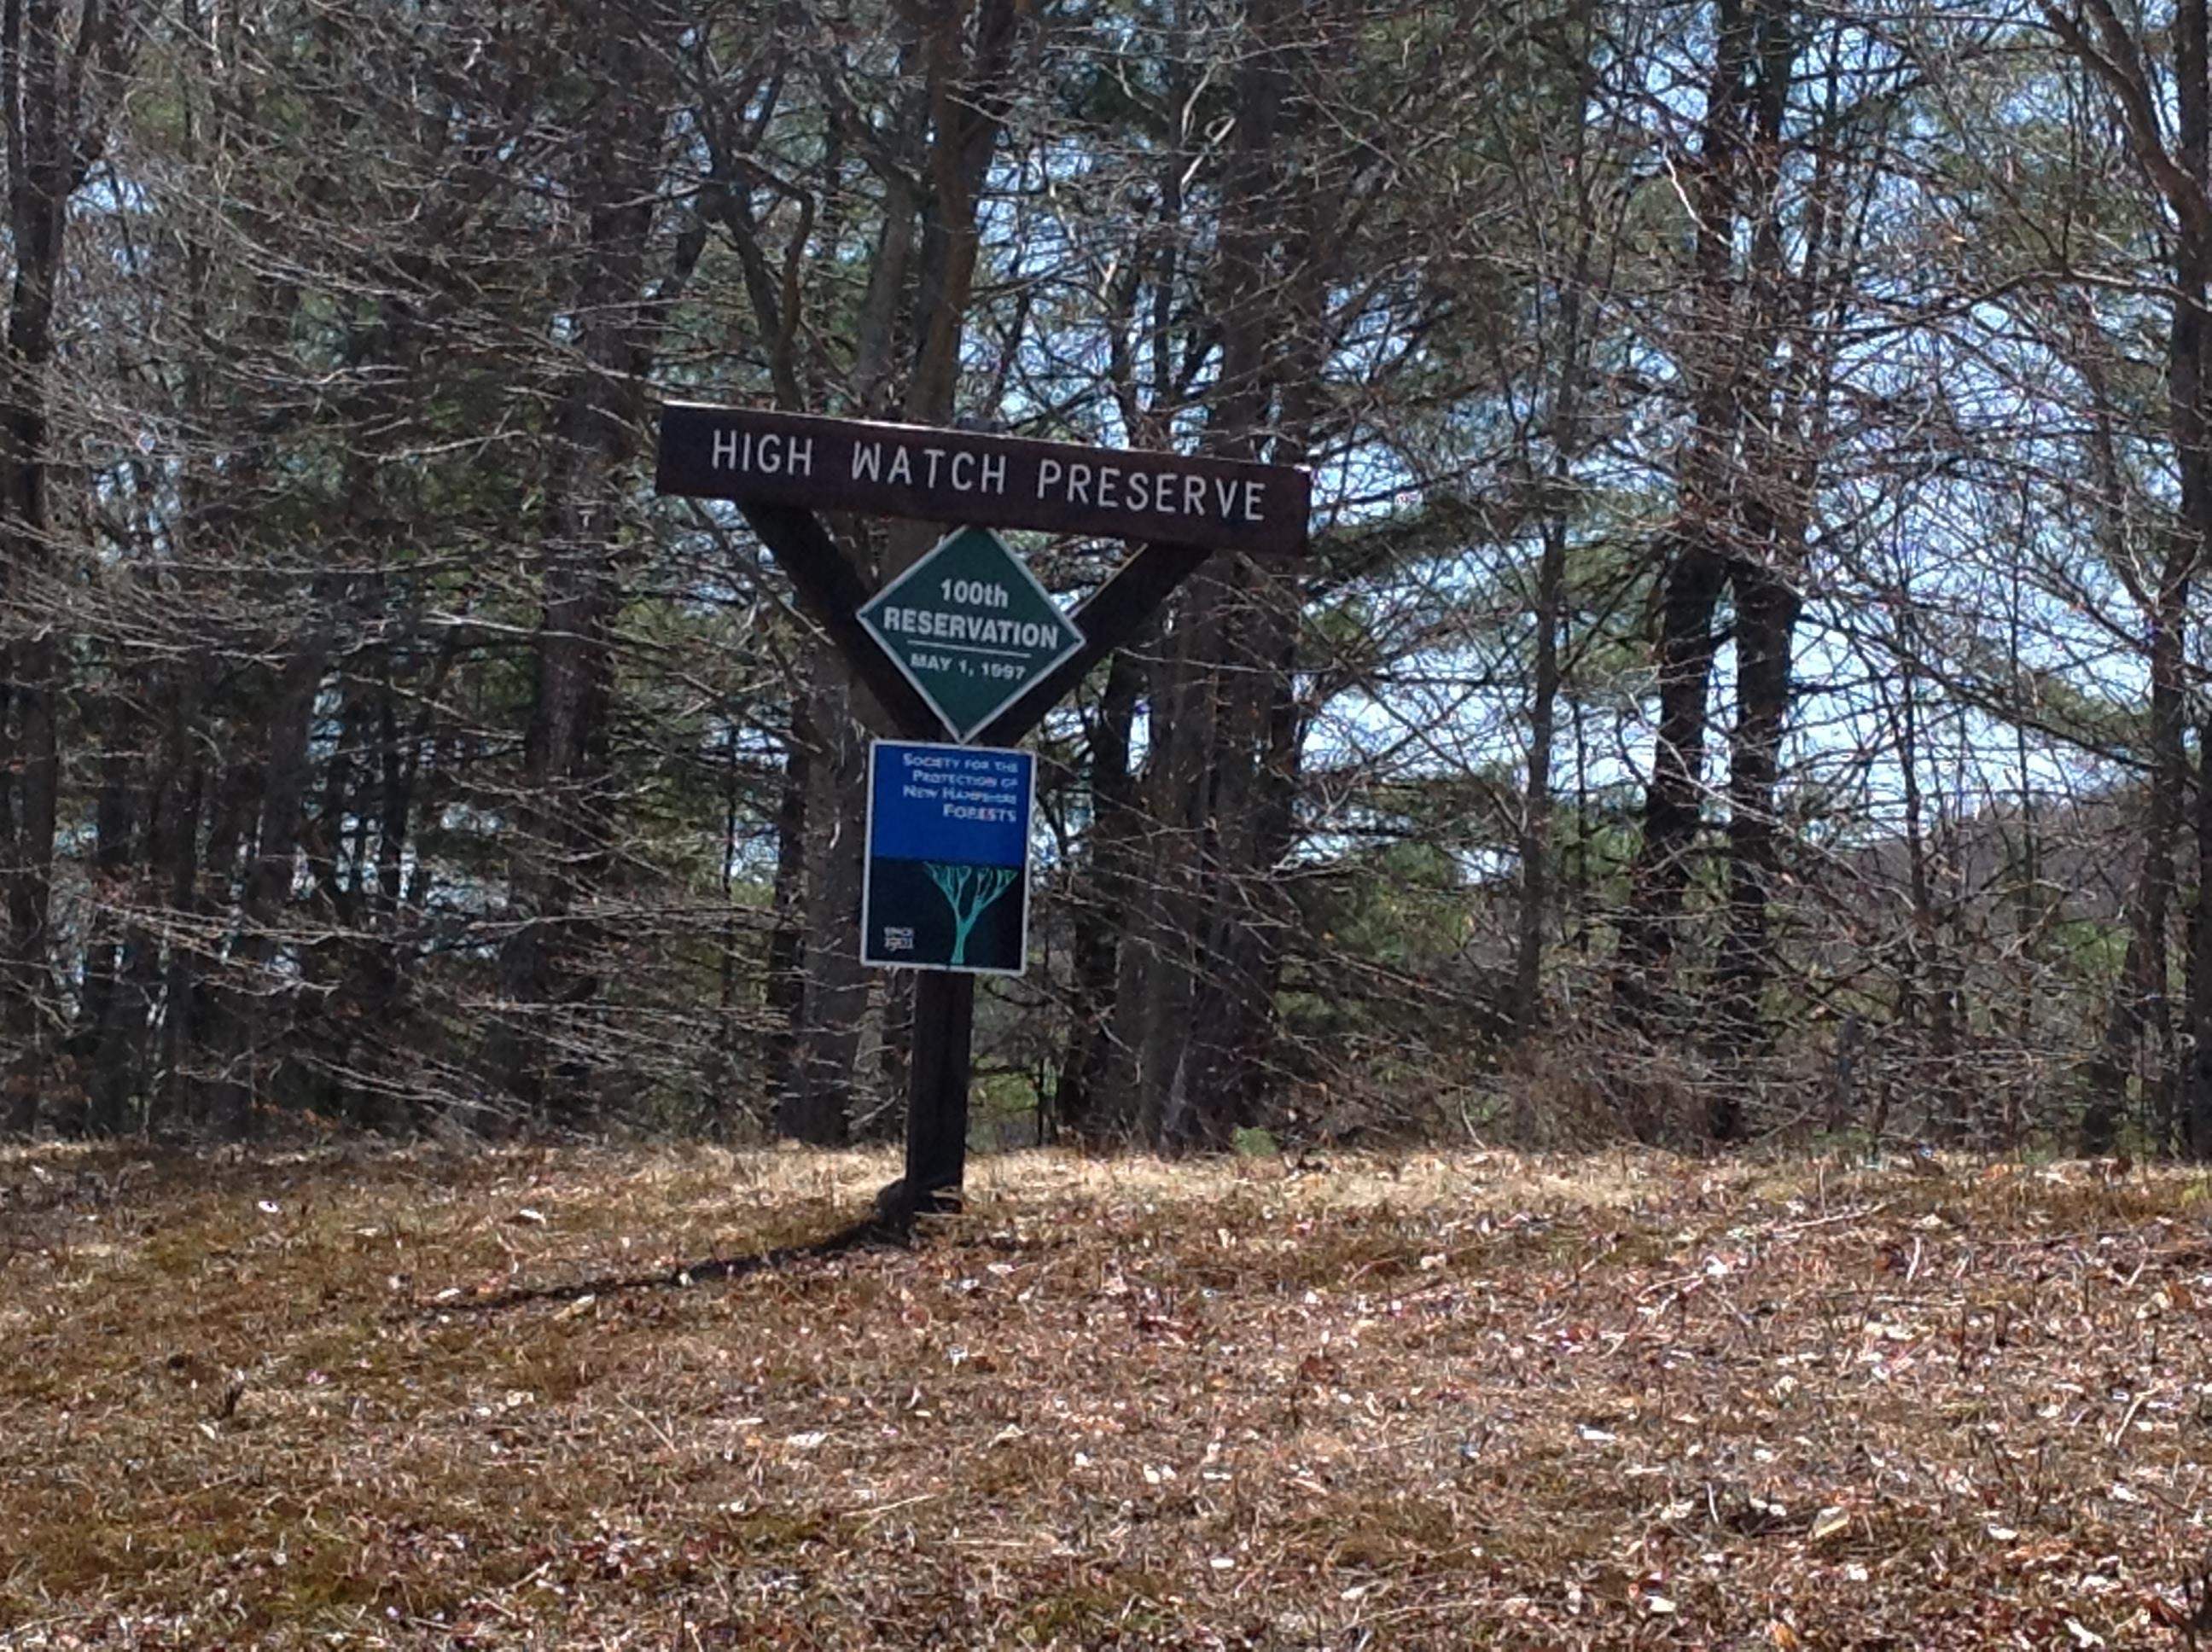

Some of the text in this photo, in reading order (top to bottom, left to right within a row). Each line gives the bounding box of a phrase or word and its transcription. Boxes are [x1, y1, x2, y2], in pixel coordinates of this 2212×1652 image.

[712, 430, 1266, 521] HIGH WATCH PRESERVE
[940, 578, 1009, 608] 100th
[883, 606, 1059, 649] RESERVATION
[910, 653, 952, 672] MAY
[958, 659, 975, 678] 1,
